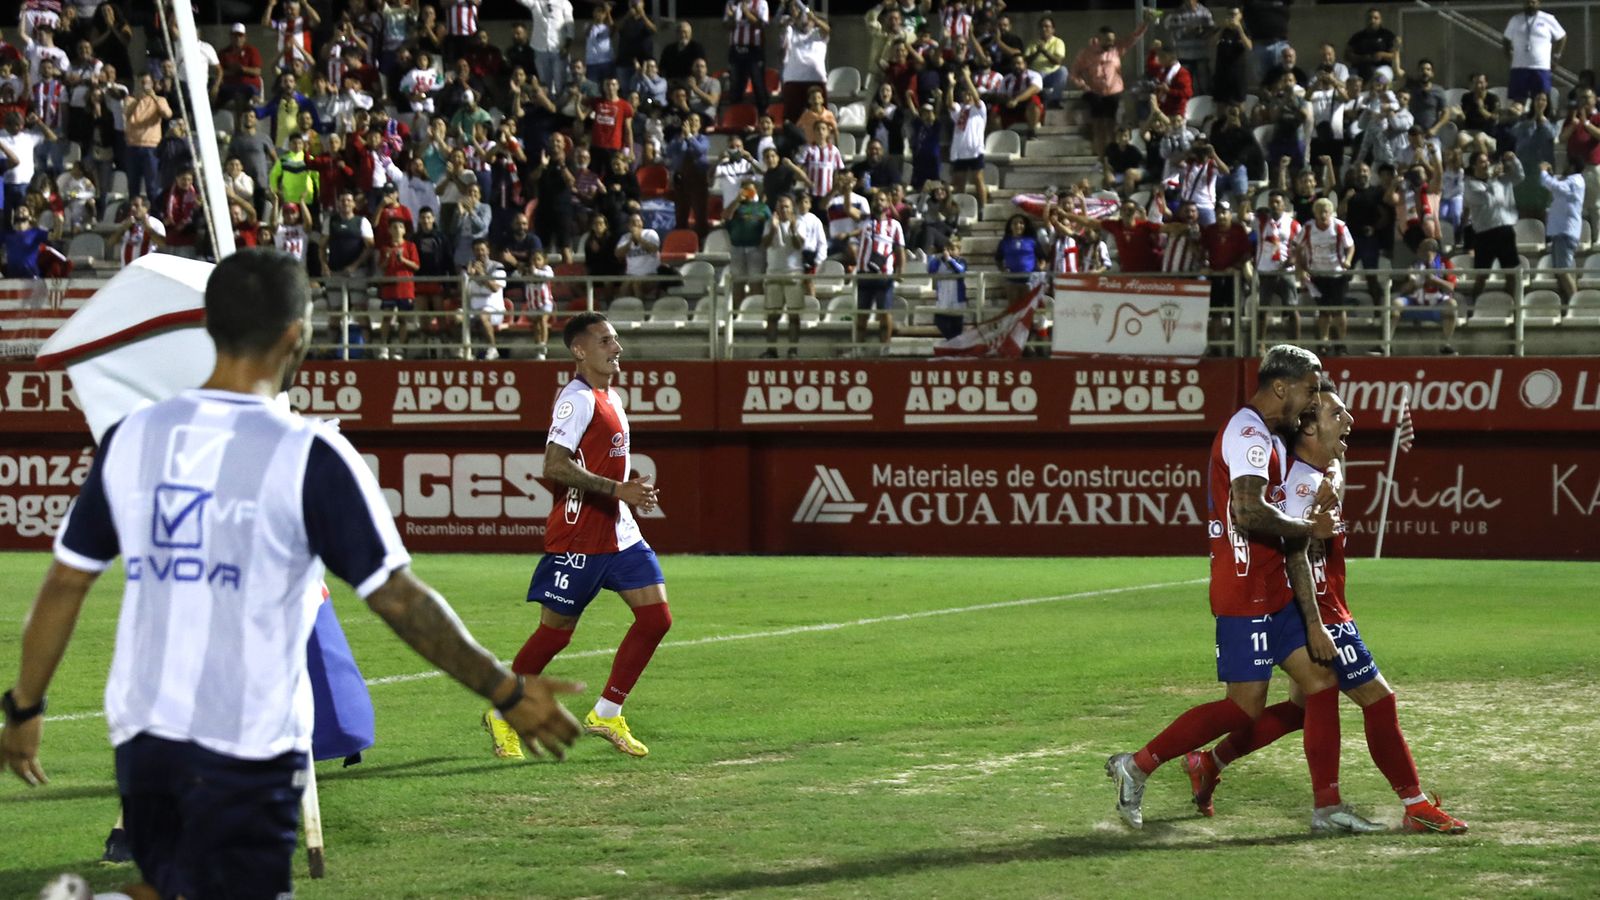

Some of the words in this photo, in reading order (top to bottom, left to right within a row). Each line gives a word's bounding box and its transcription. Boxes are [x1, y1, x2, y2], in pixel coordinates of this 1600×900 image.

[398, 371, 516, 386] UNIVERSO
[747, 371, 868, 386] UNIVERSO
[910, 371, 1032, 386] UNIVERSO
[1075, 370, 1199, 386] UNIVERSO
[0, 371, 80, 411] ER
[392, 386, 521, 411] APOLO
[742, 386, 873, 411] APOLO
[904, 386, 1038, 411] APOLO
[1070, 386, 1205, 411] APOLO
[1322, 368, 1502, 423] impiasol
[872, 464, 998, 487] Materiales
[1007, 464, 1035, 487] de
[1042, 464, 1201, 487] Construcción
[1340, 462, 1502, 515] Frida
[0, 494, 78, 537] agg
[869, 492, 1000, 525] AGUA
[1010, 492, 1203, 525] MARINA
[406, 522, 474, 536] Recambios
[475, 522, 497, 536] del
[1452, 520, 1489, 534] PUB
[554, 570, 570, 590] 16
[544, 591, 575, 606] GIVOVA
[1251, 631, 1268, 652] 11
[1337, 644, 1358, 666] 10
